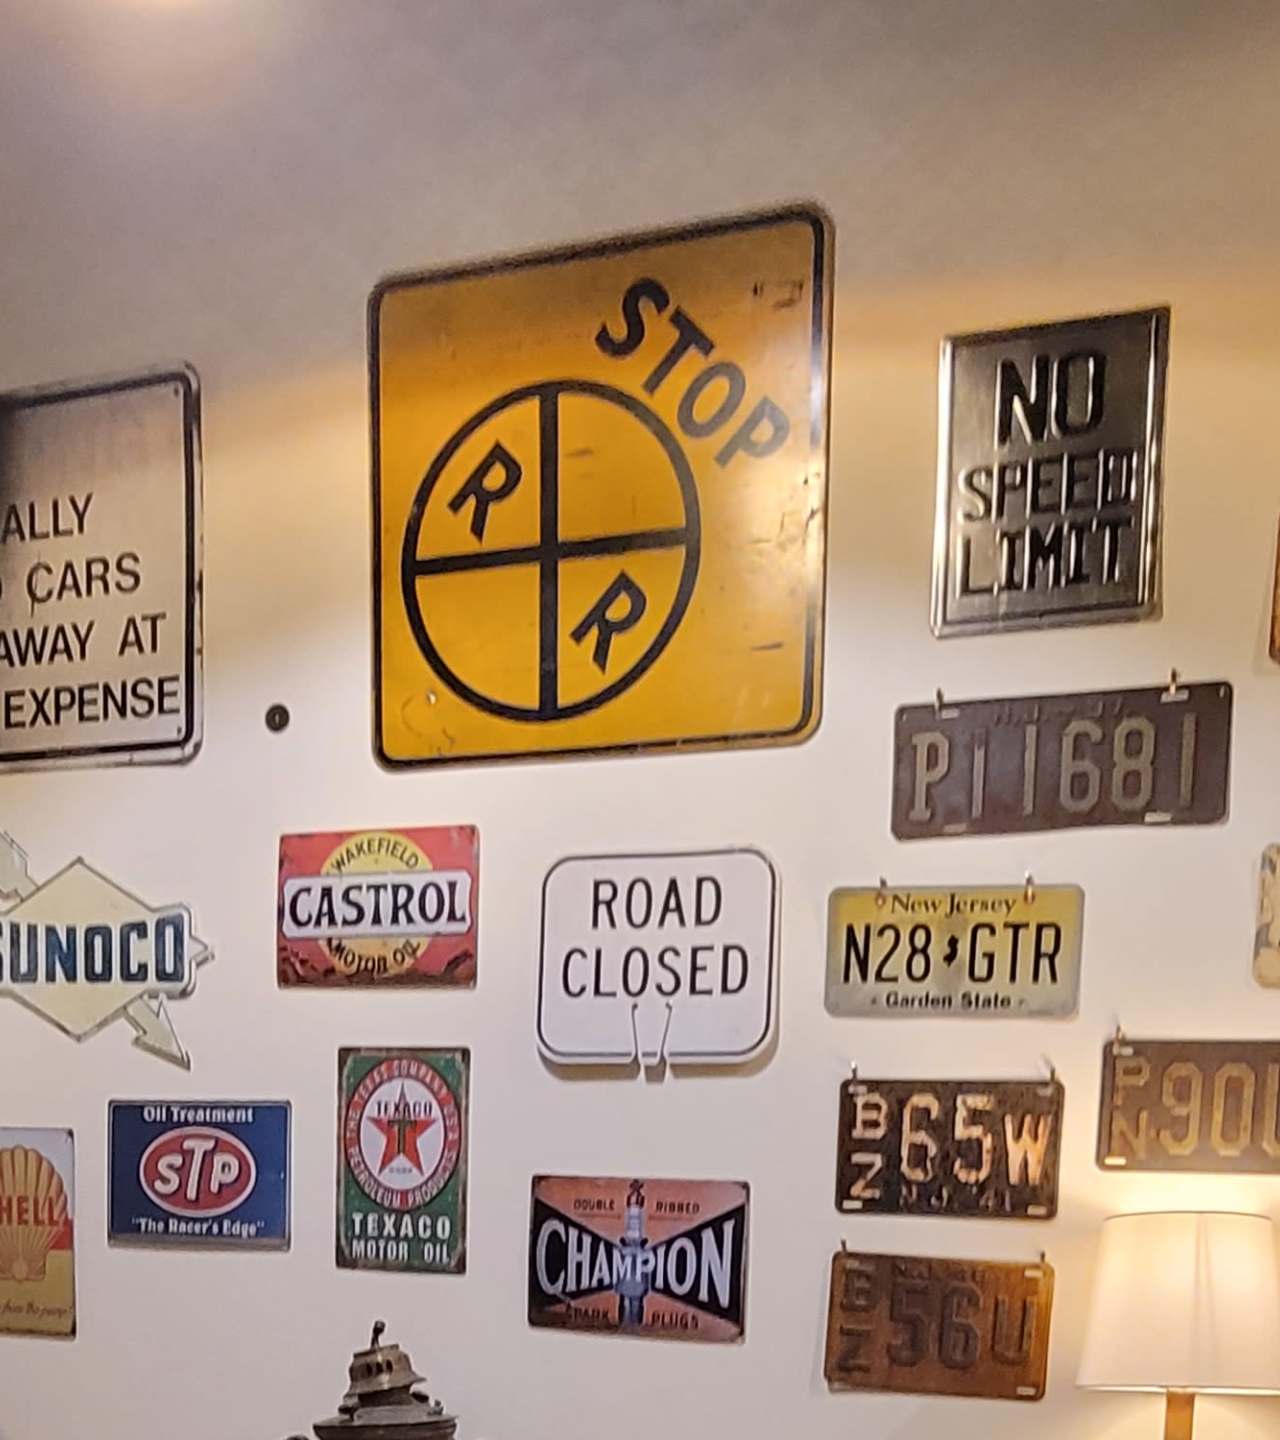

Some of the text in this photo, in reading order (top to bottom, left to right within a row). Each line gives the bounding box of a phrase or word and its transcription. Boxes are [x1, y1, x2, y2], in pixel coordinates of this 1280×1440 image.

[595, 277, 790, 466] STOP
[994, 354, 1106, 450] NO
[447, 440, 523, 543] R
[957, 448, 1138, 524] SPEED
[26, 552, 141, 604] CARS
[956, 516, 1135, 600] LIMIT
[118, 613, 167, 656] AT
[570, 570, 647, 675] R
[3, 675, 181, 731] EXPENSE
[331, 836, 419, 873] WAKEFIELD
[289, 880, 467, 928] CASTROL
[592, 876, 722, 930] ROAD
[891, 892, 1017, 918] New Jersey
[326, 937, 389, 976] MOTOR
[562, 945, 749, 999] CLOSED
[885, 991, 1012, 1009] Garden State
[143, 1106, 254, 1124] Oil Treatment
[900, 1092, 1052, 1186] 65W
[153, 1138, 240, 1201] STP
[168, 1218, 219, 1236] Racer's
[352, 1212, 451, 1240] TEXACO
[574, 1198, 615, 1212] DOUBLE
[352, 1239, 450, 1265] MOTOR OIL
[536, 1218, 736, 1309] CHAMPION
